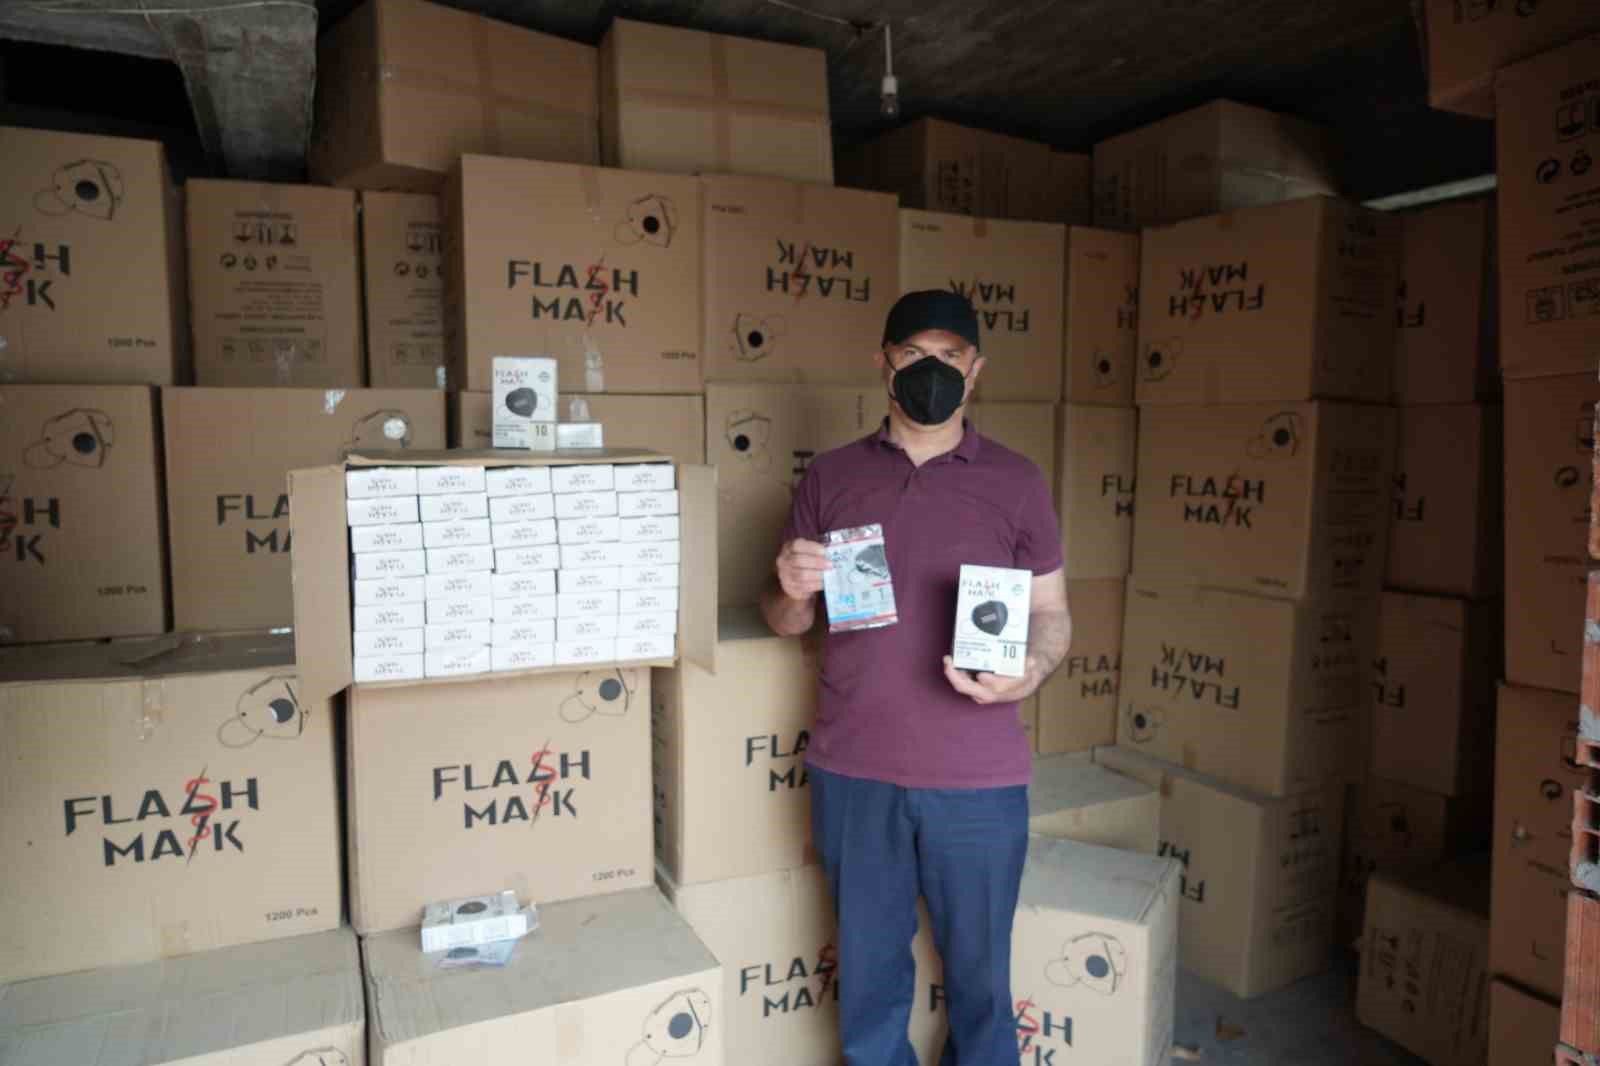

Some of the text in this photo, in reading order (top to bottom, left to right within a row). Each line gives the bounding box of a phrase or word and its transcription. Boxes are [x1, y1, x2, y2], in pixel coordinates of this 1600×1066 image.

[508, 259, 639, 298] FLASH
[766, 267, 870, 302] FLASH
[532, 294, 626, 328] MASK
[1170, 474, 1265, 504] FLASH
[1184, 503, 1251, 528] MASK
[1003, 645, 1017, 659] 10
[433, 749, 590, 801] FLASH
[64, 777, 258, 837] FLASH
[464, 788, 577, 828] MASK
[103, 818, 243, 866] MASK
